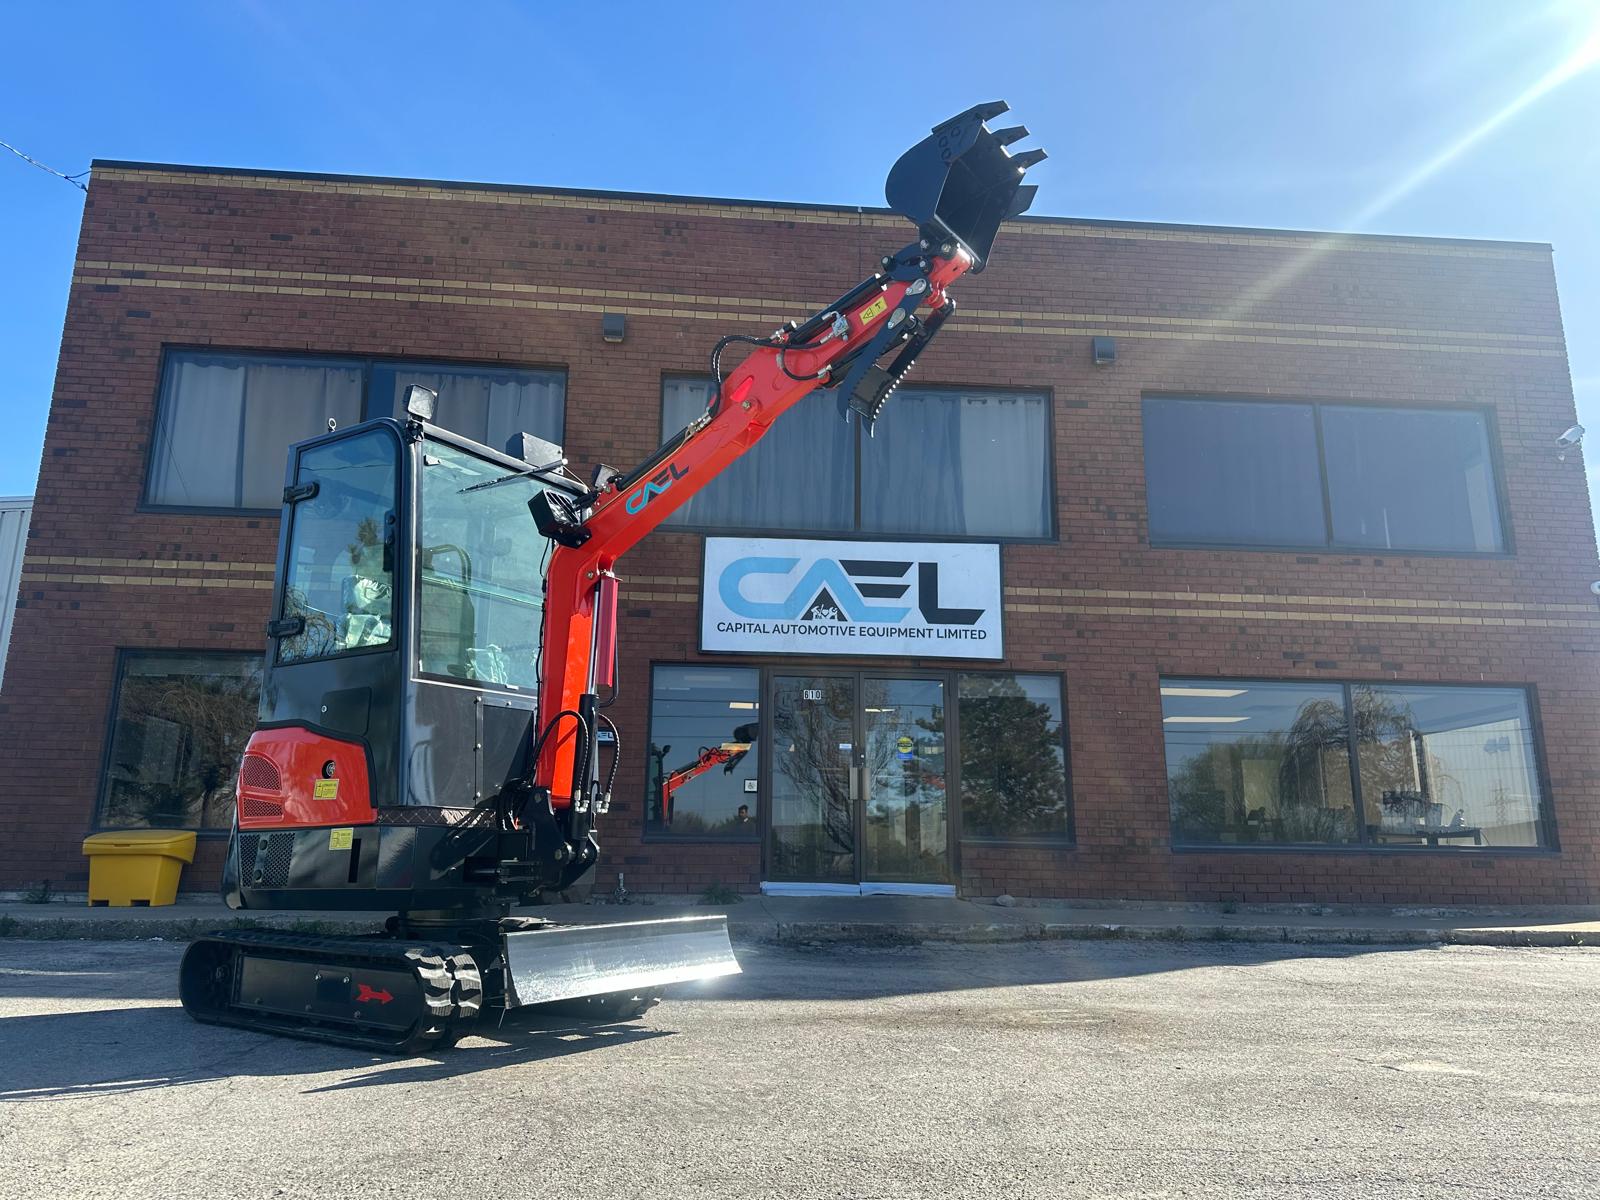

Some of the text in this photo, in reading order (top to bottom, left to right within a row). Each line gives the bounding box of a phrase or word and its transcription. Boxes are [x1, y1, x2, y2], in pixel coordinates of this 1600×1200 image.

[625, 462, 690, 515] CAEL
[718, 556, 986, 626] CAEL
[717, 622, 987, 640] CAPITAL AUTOMOTIVE EQUIPMENT LIMITED
[804, 690, 821, 699] 610
